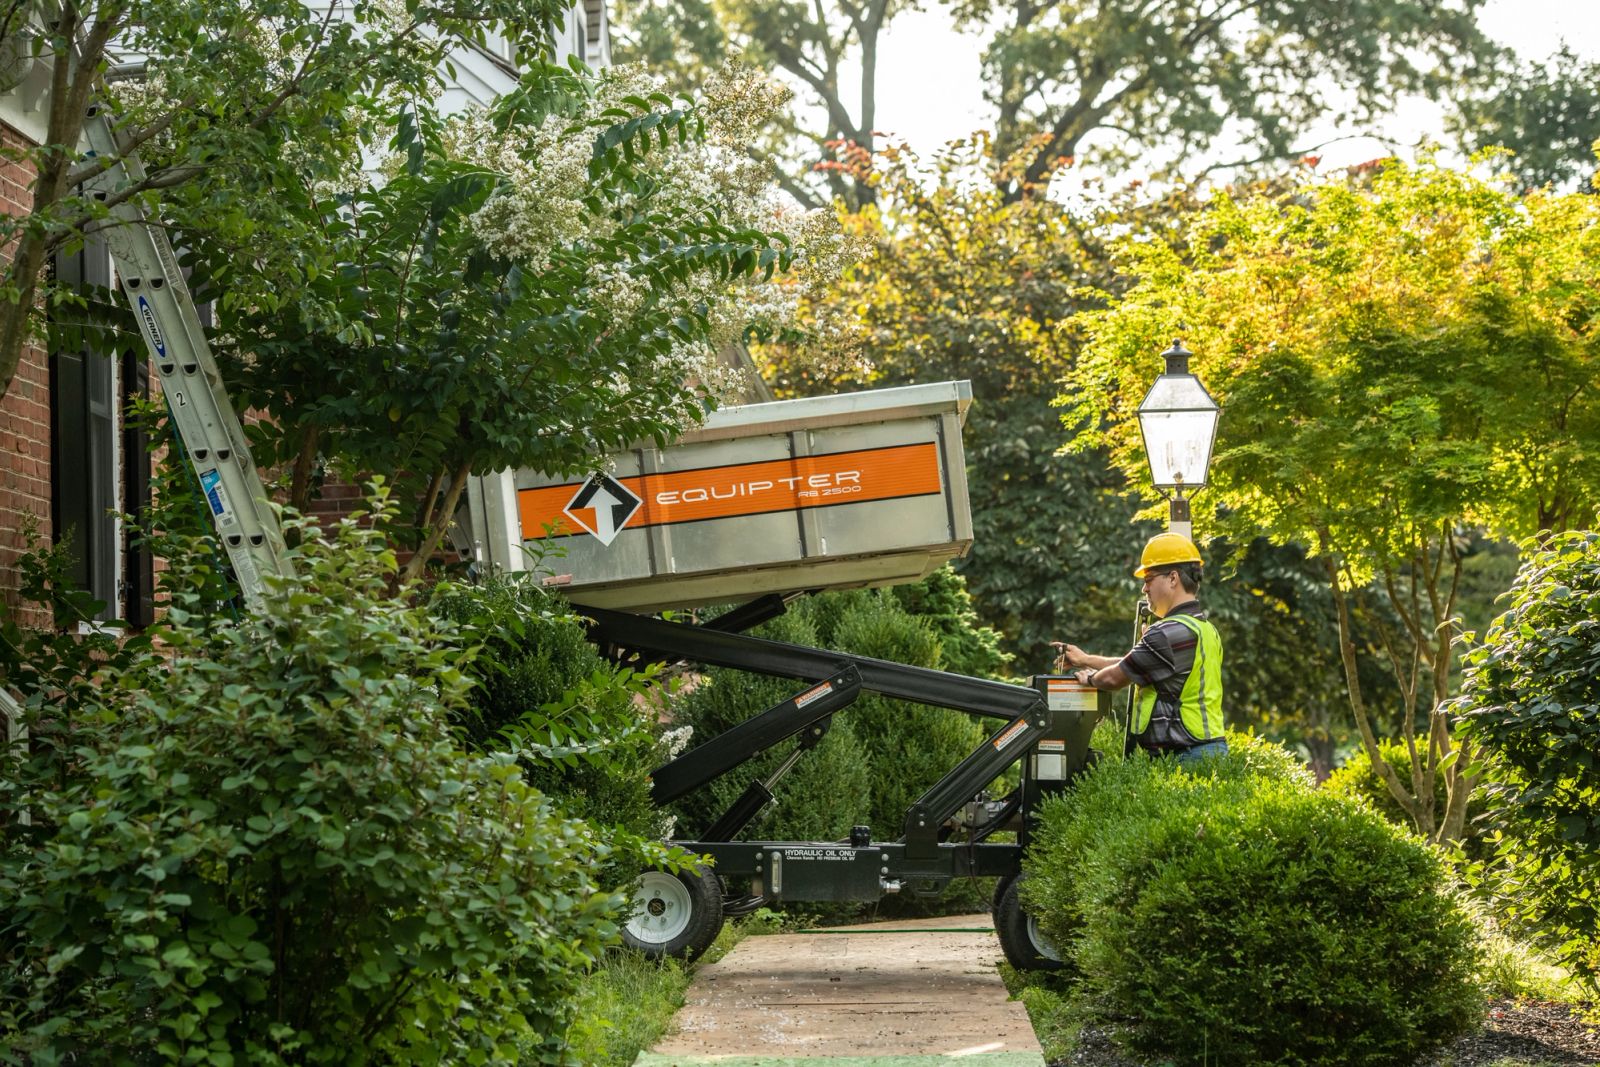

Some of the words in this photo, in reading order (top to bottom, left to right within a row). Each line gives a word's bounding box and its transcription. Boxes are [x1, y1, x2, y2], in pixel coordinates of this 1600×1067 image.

[143, 308, 162, 346] WERNER
[176, 392, 186, 406] 2
[656, 470, 861, 505] EQUIPTER
[798, 490, 818, 498] RB
[822, 485, 862, 497] 2500
